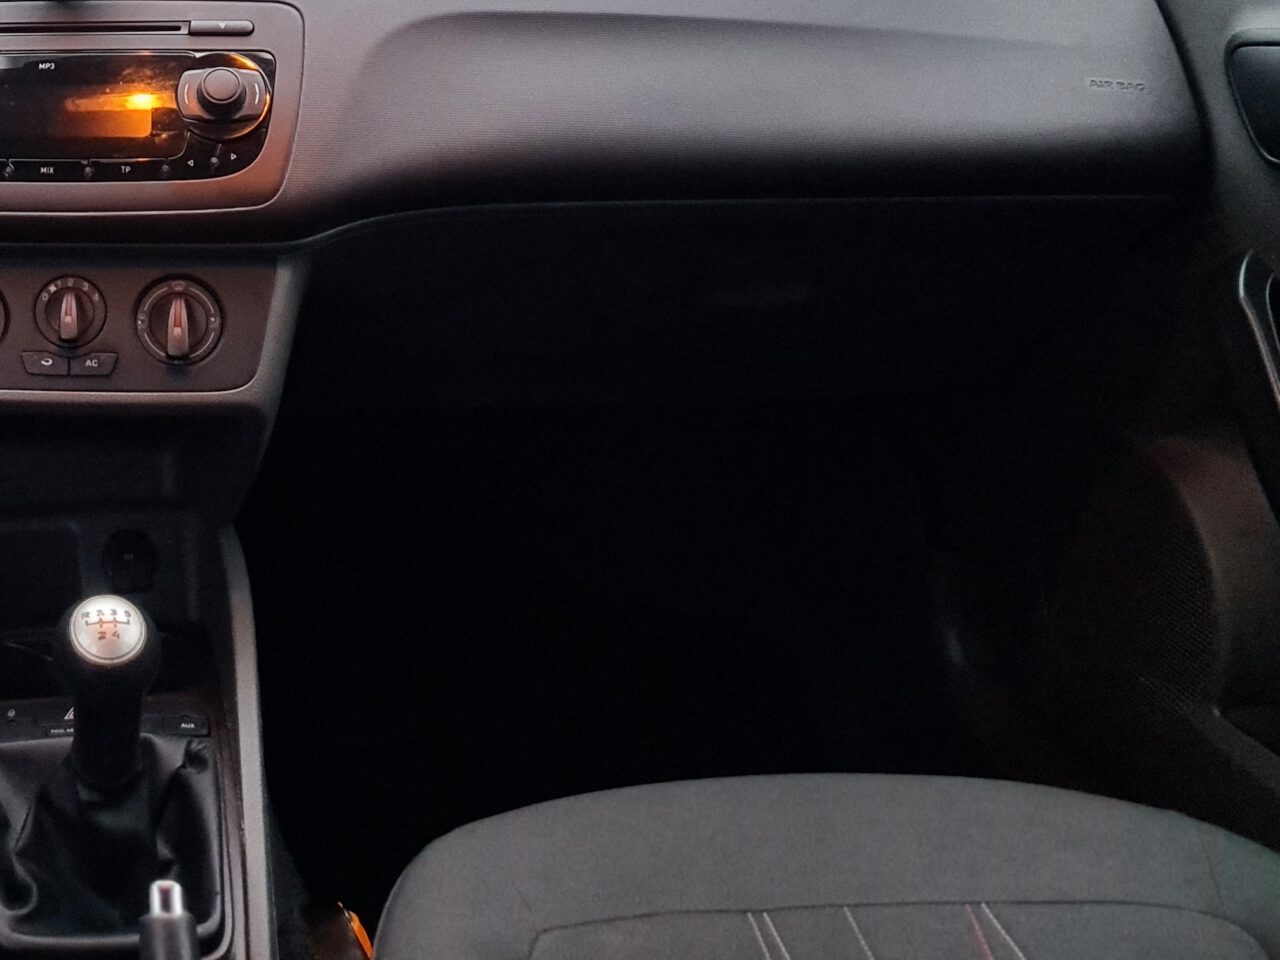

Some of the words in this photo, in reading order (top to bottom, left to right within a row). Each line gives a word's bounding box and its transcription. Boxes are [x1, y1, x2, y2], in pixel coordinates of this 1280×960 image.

[38, 62, 55, 70] MP3
[40, 166, 55, 174] MIX
[121, 165, 131, 173] TP
[82, 281, 89, 291] 3
[85, 359, 99, 367] AC
[111, 630, 120, 640] 4
